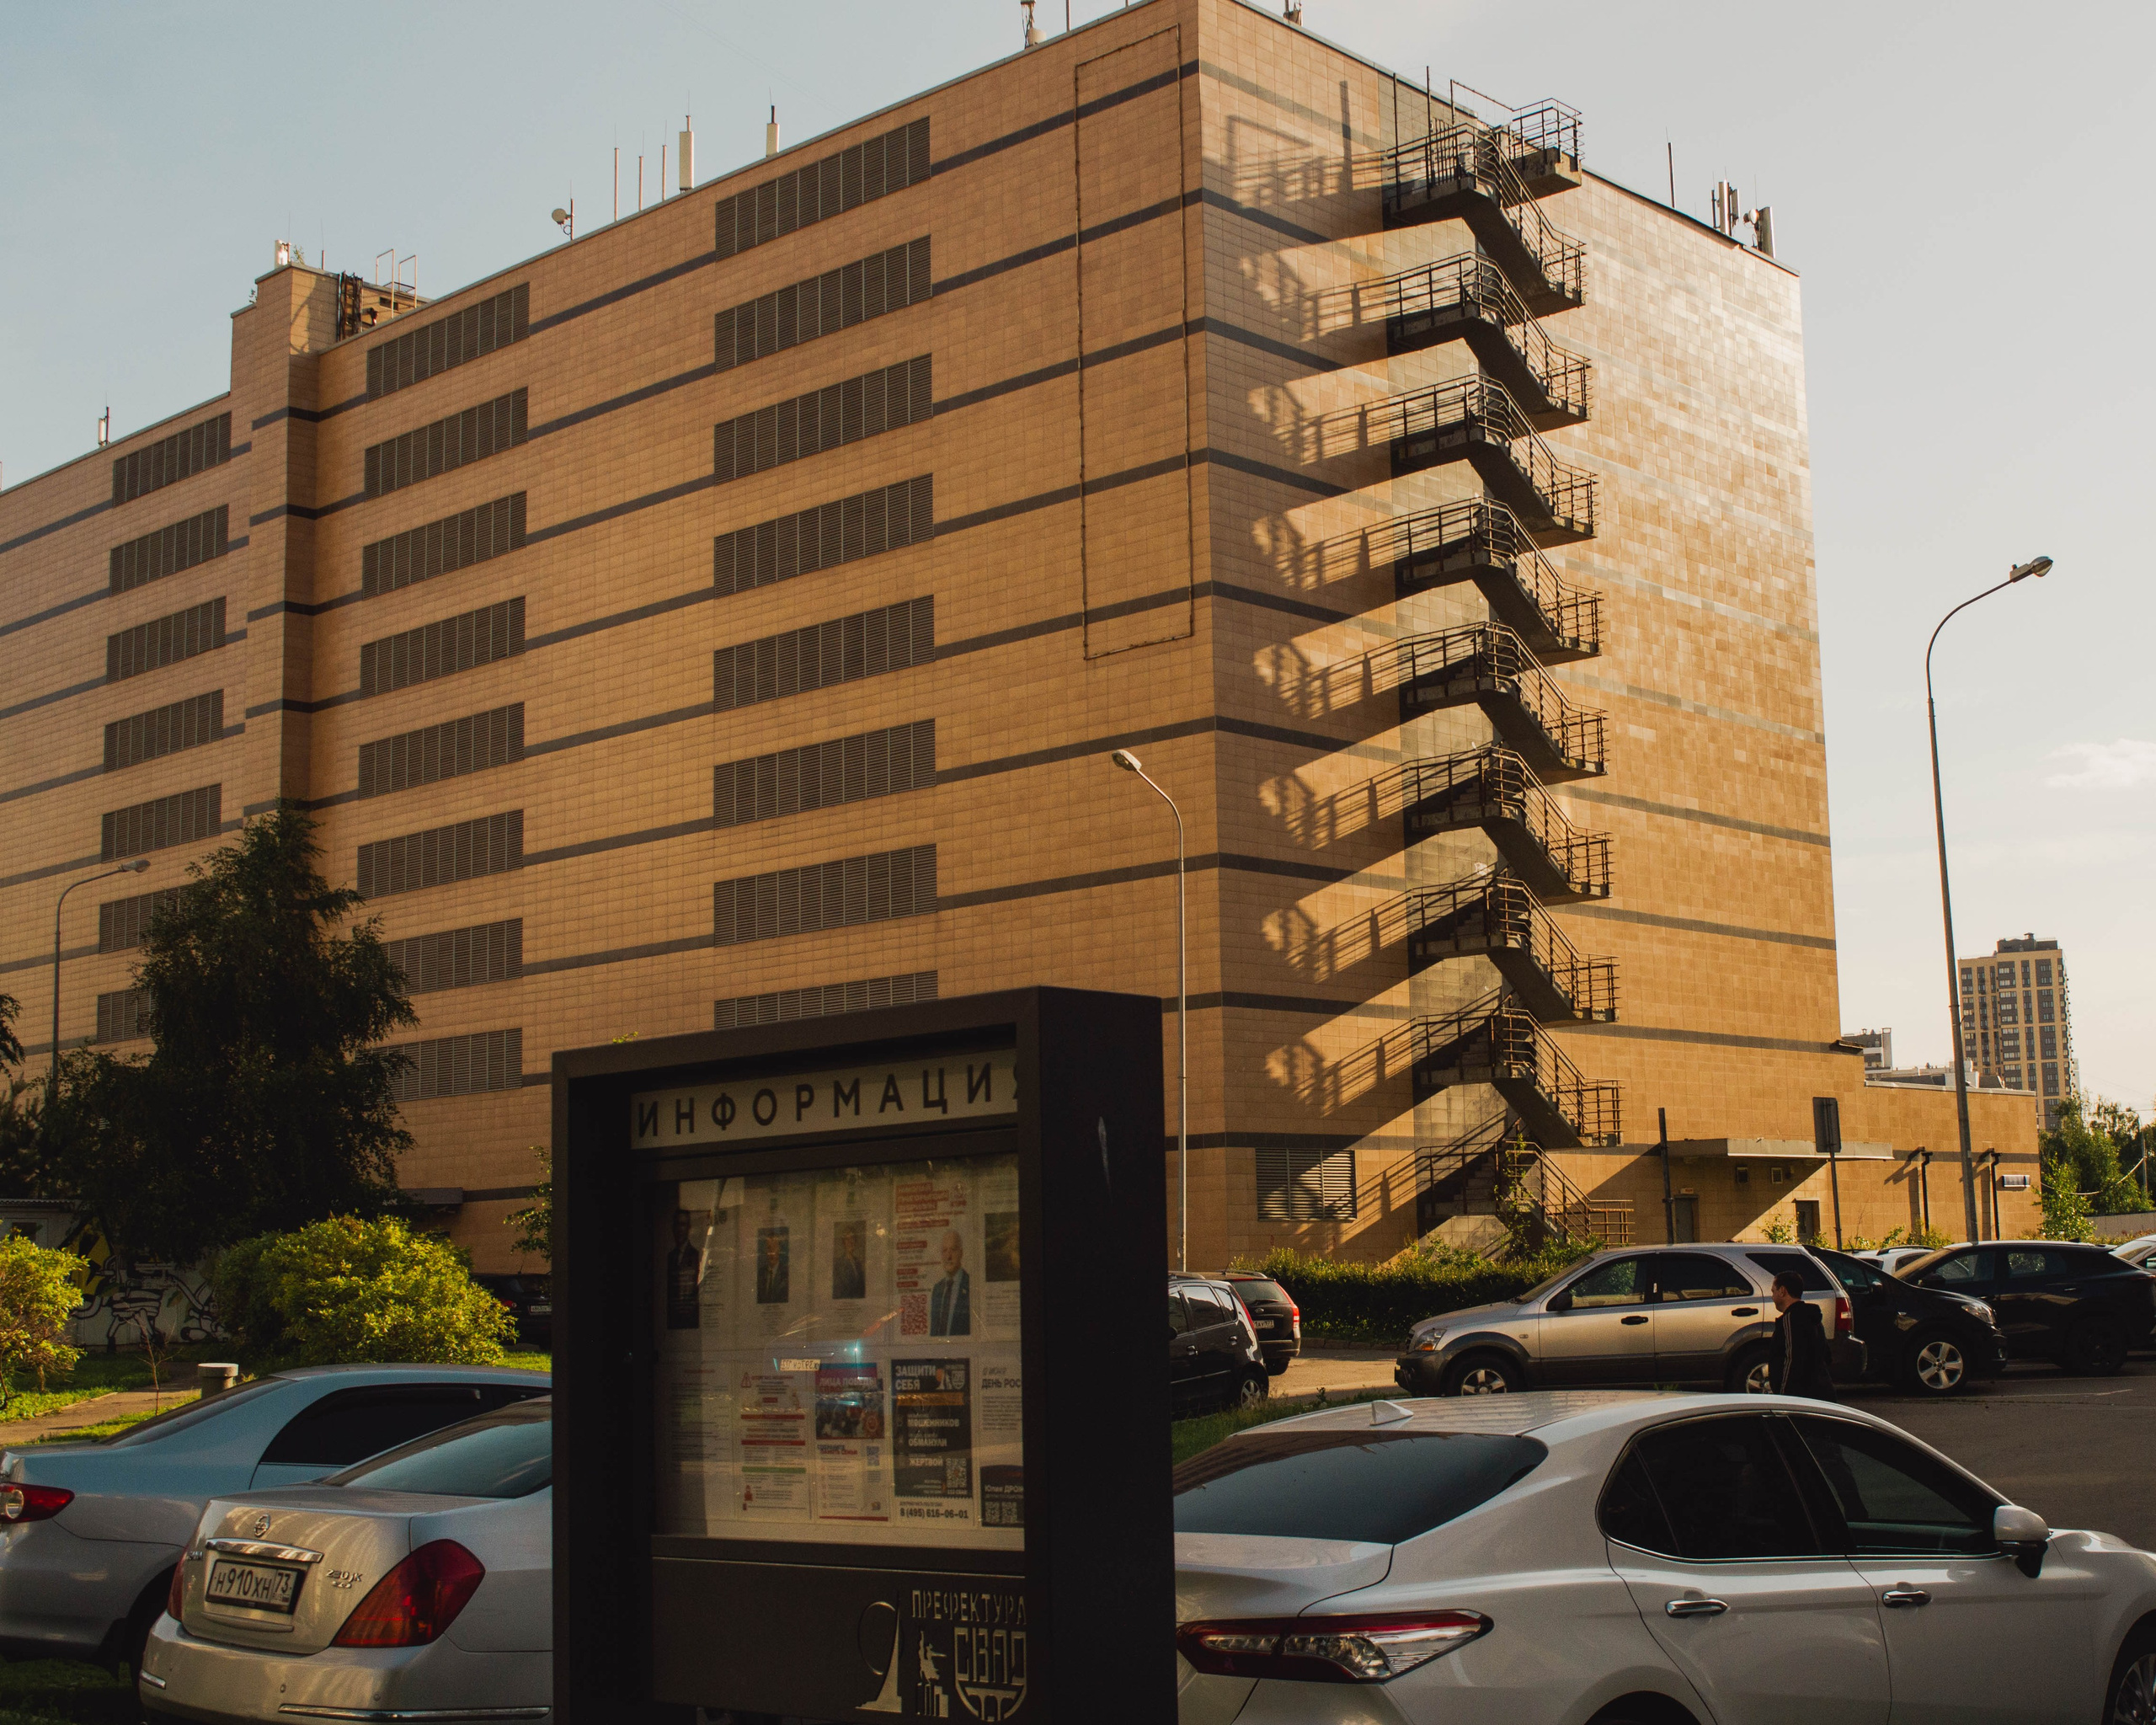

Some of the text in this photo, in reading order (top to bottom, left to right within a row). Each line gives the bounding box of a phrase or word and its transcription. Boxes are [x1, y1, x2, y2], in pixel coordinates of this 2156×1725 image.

[638, 1061, 1018, 1137] ИНФОРМАЦИ
[895, 1365, 936, 1377] ЗАЩИТИ
[895, 1379, 921, 1391] СЕБЯ
[982, 1378, 1002, 1389] ДЕНЬ
[907, 1418, 960, 1428] МОШЕННИКОВ
[909, 1455, 944, 1467] ЖЕРТВОЙ
[899, 1507, 905, 1517] 8
[906, 1508, 925, 1519] (495)
[215, 1567, 289, 1599] Н910ХН 73
[911, 1589, 1027, 1625] ПРЕФЕКТУРА
